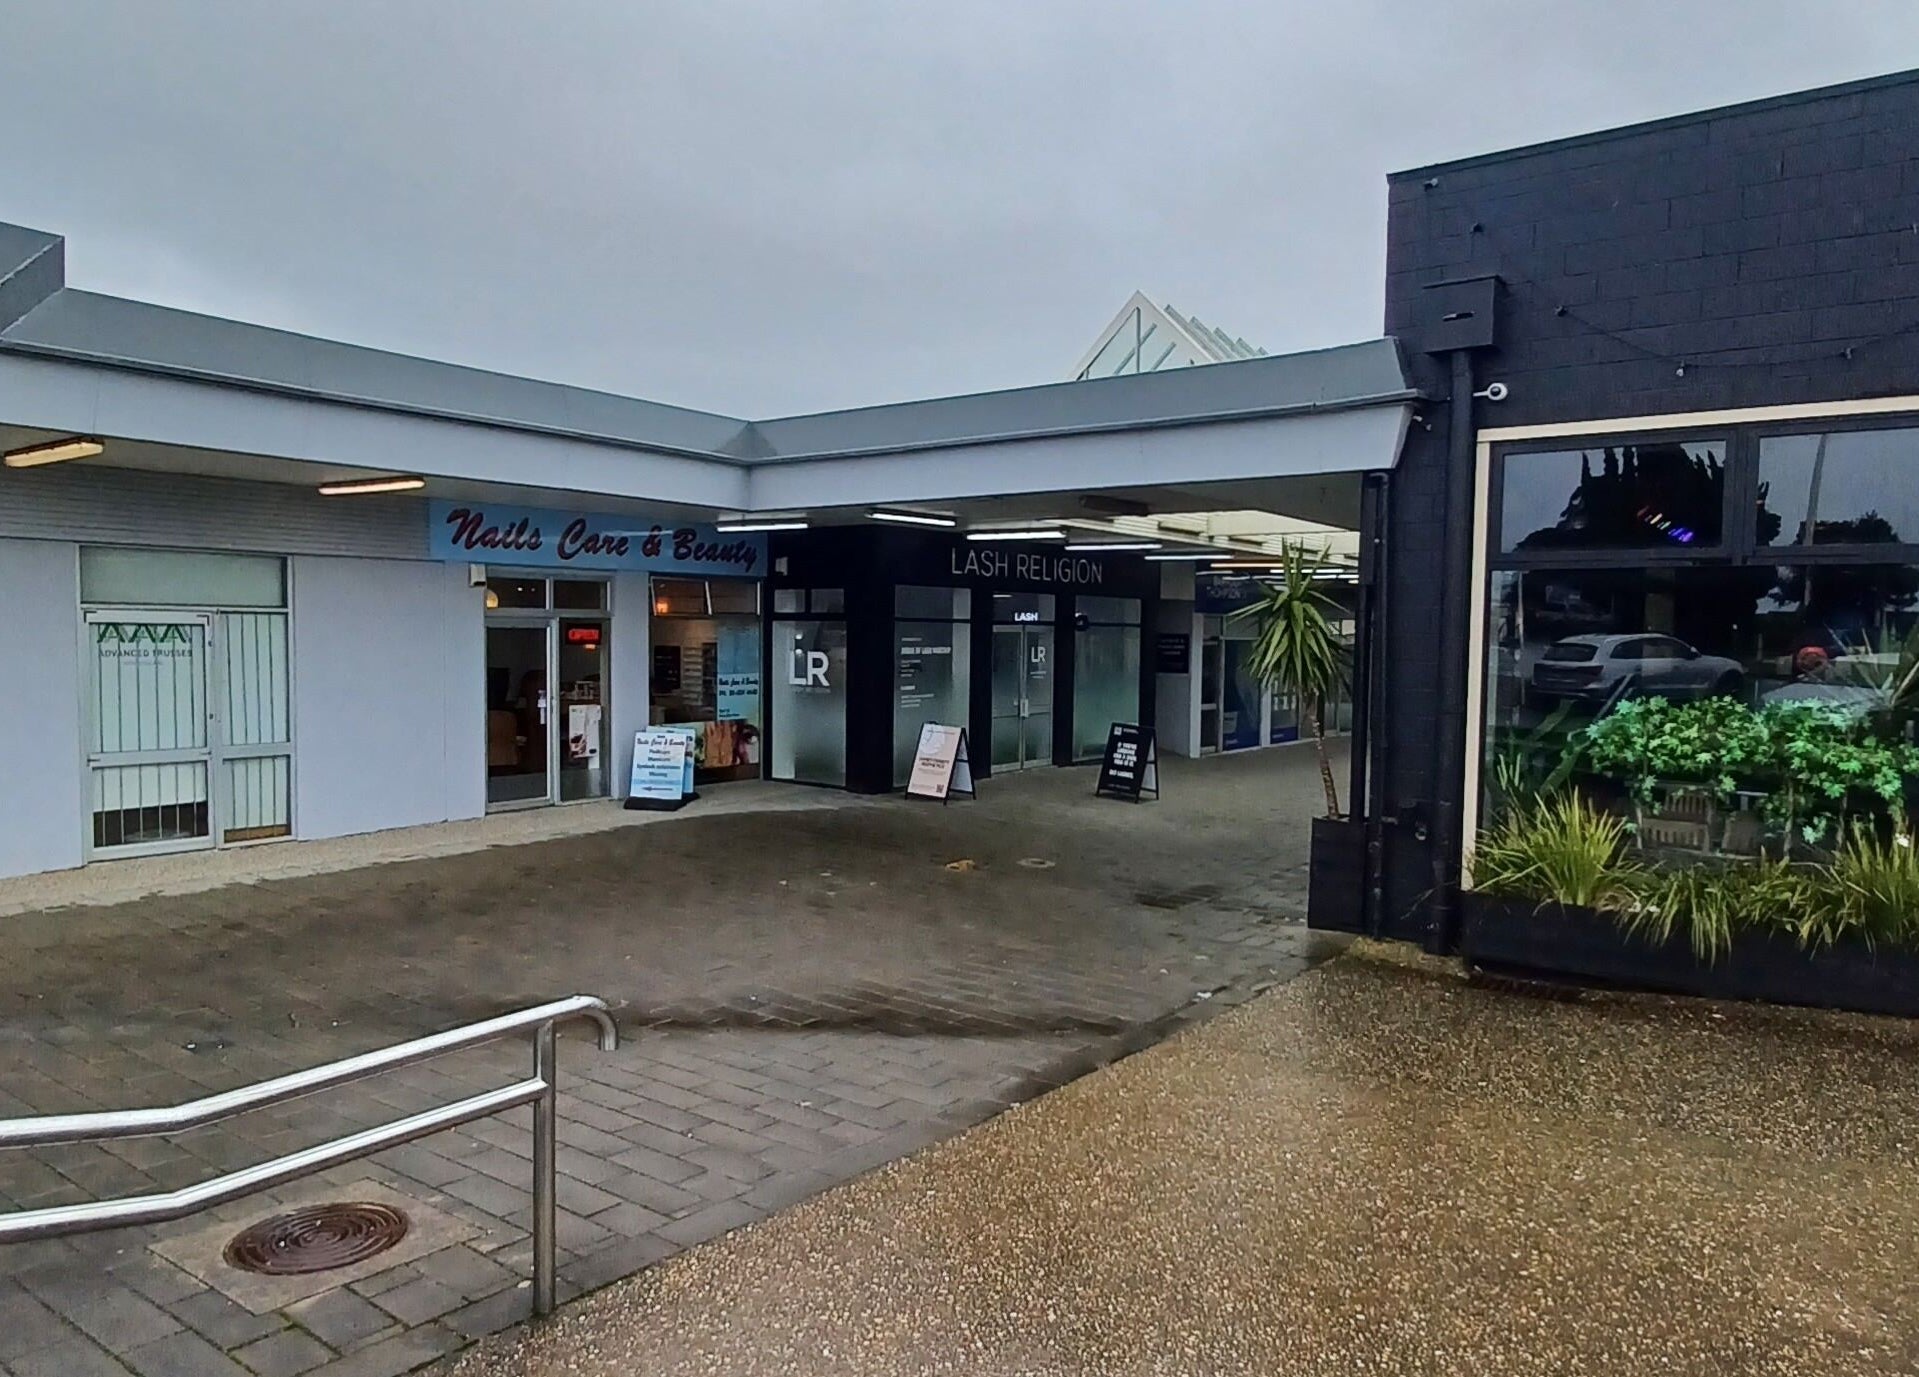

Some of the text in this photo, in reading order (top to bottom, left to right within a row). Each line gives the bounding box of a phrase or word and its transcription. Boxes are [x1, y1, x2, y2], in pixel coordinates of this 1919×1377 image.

[447, 508, 757, 573] Nails Care & Beauty
[951, 547, 1103, 584] LASH RELIGION
[1014, 612, 1039, 622] LASH
[99, 649, 150, 657] ADVANCED
[1030, 646, 1047, 663] LR
[789, 650, 830, 687] LR
